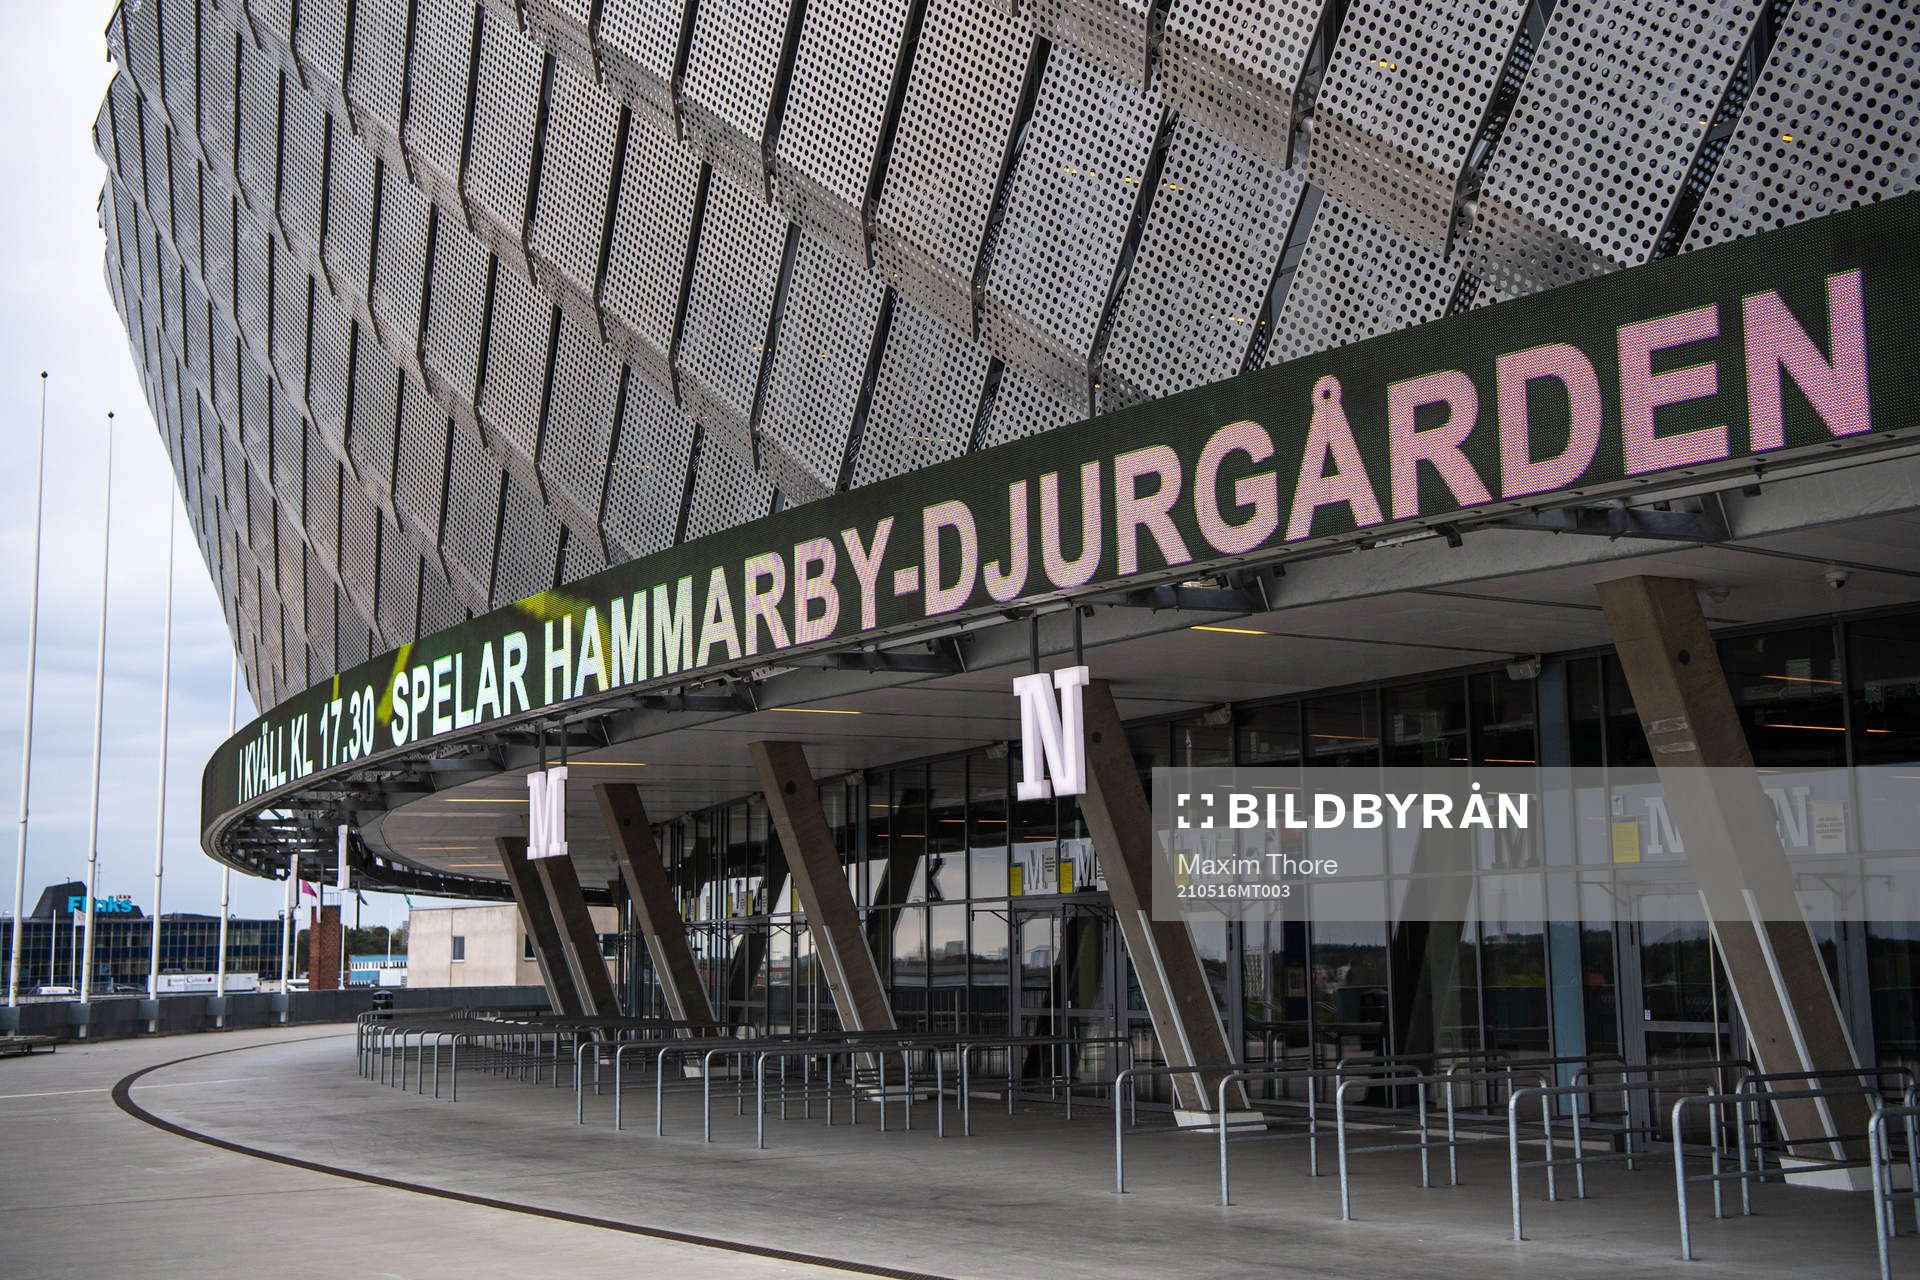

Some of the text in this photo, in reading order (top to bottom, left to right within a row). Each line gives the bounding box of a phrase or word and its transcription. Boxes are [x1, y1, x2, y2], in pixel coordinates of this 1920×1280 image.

[244, 721, 287, 802] KVÄLL
[290, 713, 313, 782] KL
[319, 684, 375, 770] 17.30
[391, 631, 530, 747] SPELAR
[544, 267, 1873, 706] HAMMARBY-DJURGÅRDEN
[1013, 665, 1090, 801] N
[526, 766, 569, 860] M
